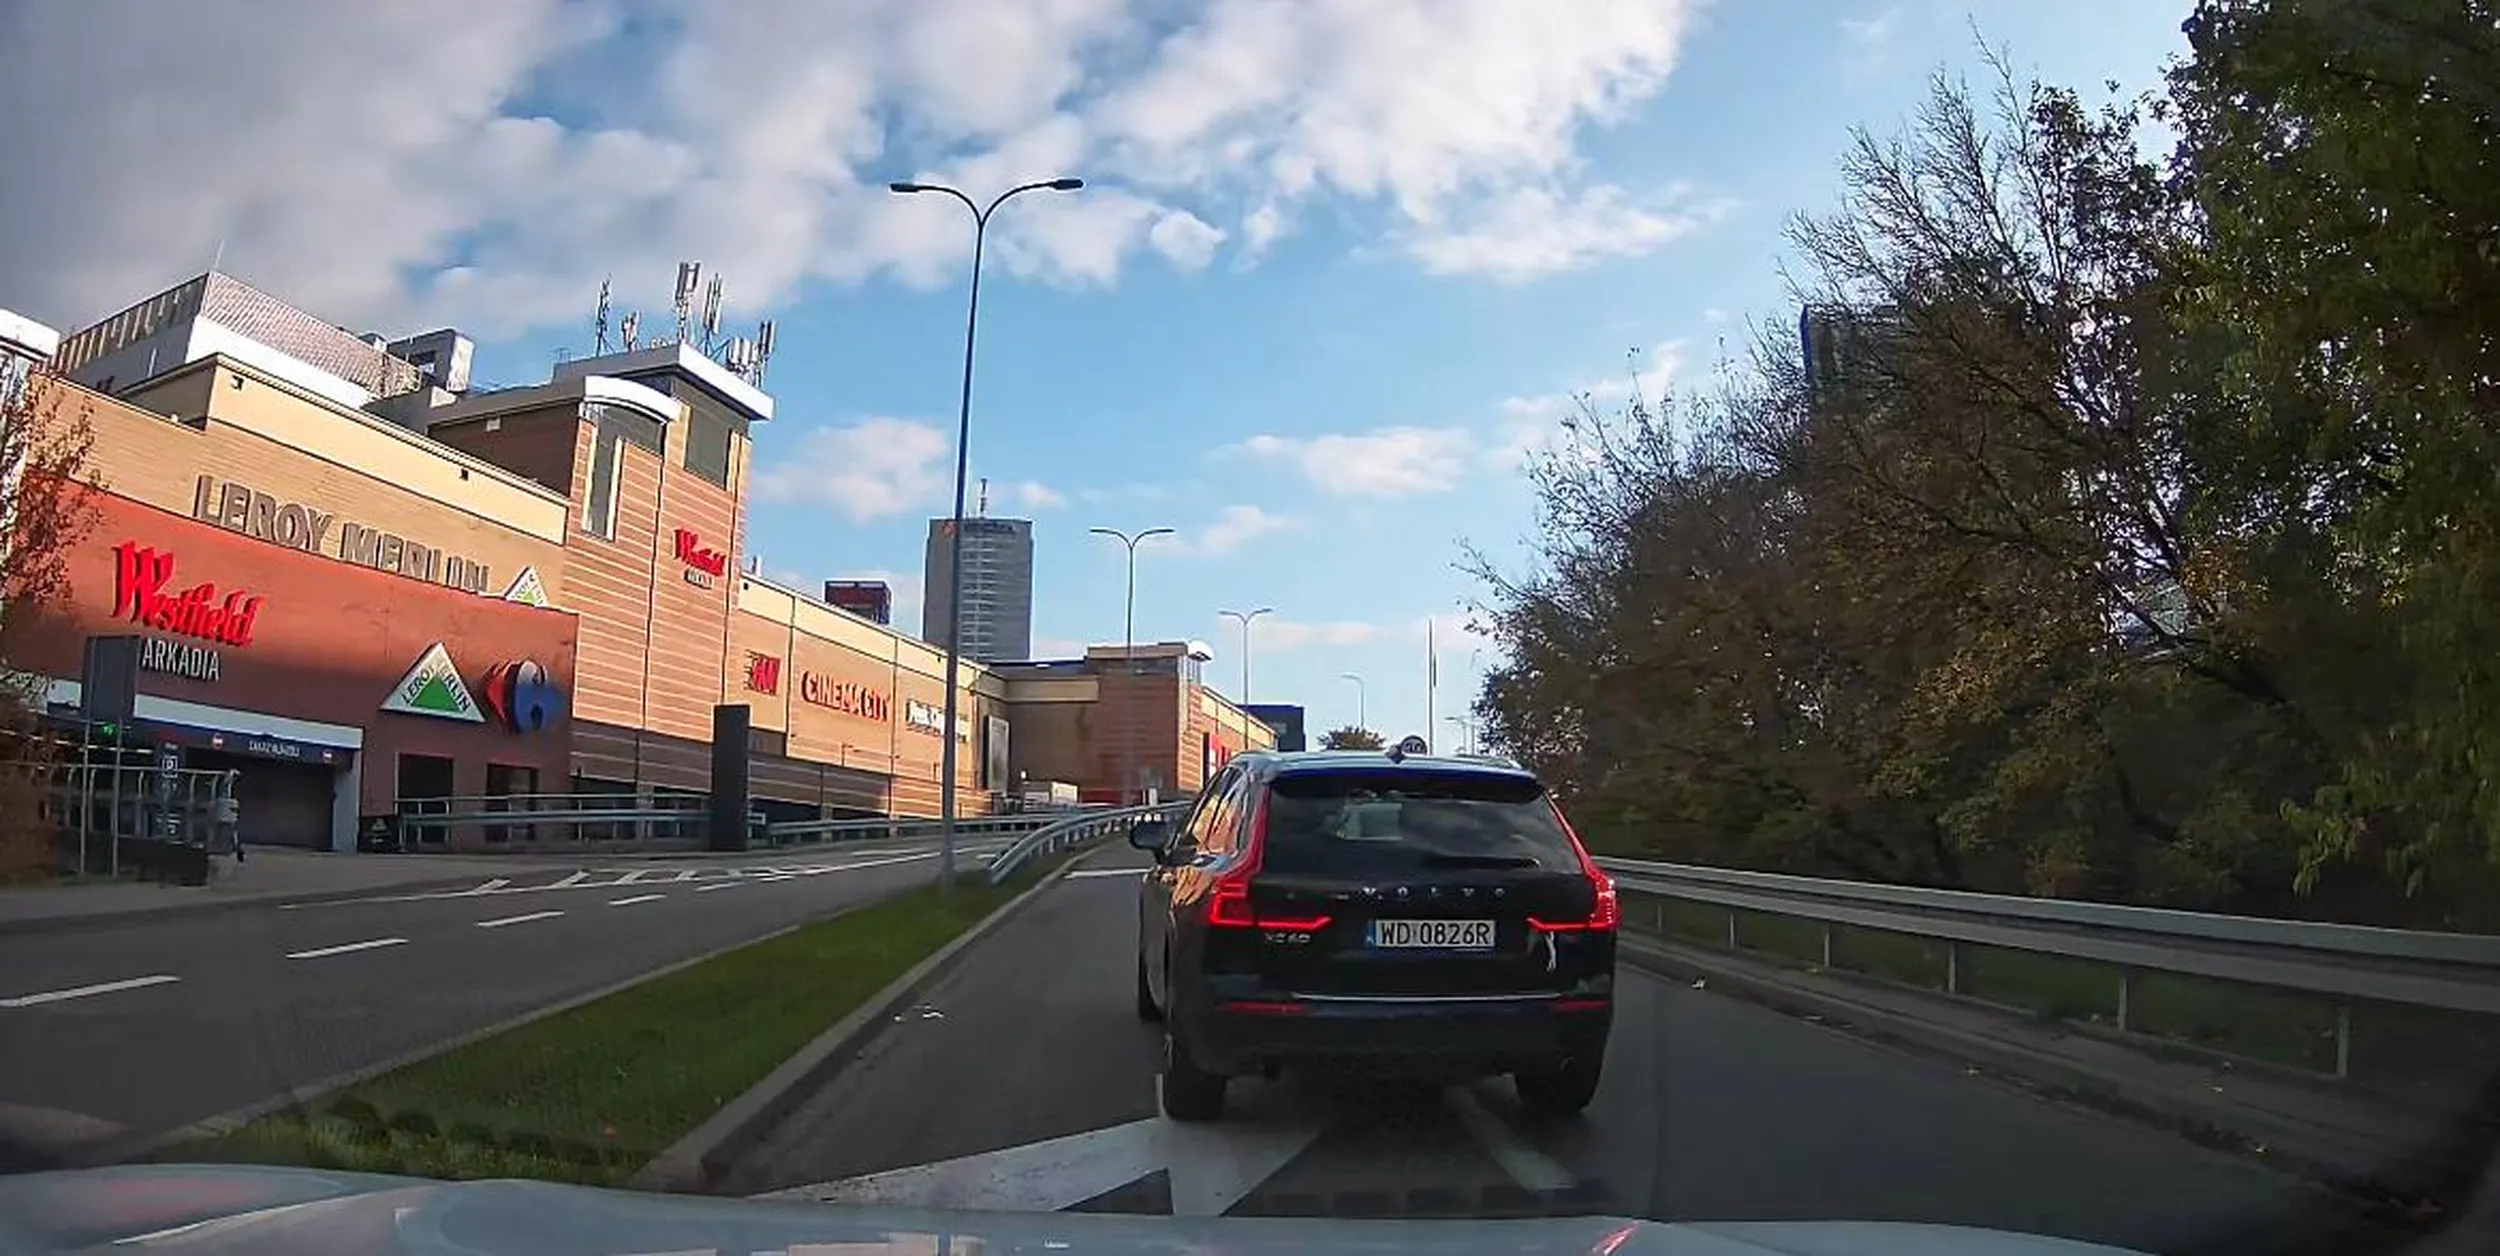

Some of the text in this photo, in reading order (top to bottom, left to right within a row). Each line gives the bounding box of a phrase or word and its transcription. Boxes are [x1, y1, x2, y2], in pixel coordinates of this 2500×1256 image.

[194, 474, 333, 552] LEROY
[339, 521, 490, 594] MERLIN
[110, 539, 266, 648] Westfield
[141, 638, 220, 681] ARKADIA
[437, 658, 471, 712] ERLIN
[801, 670, 859, 715] CINEMA
[860, 685, 891, 722] CITY
[1363, 886, 1505, 897] VOLVO
[1381, 922, 1491, 945] WD 0826R
